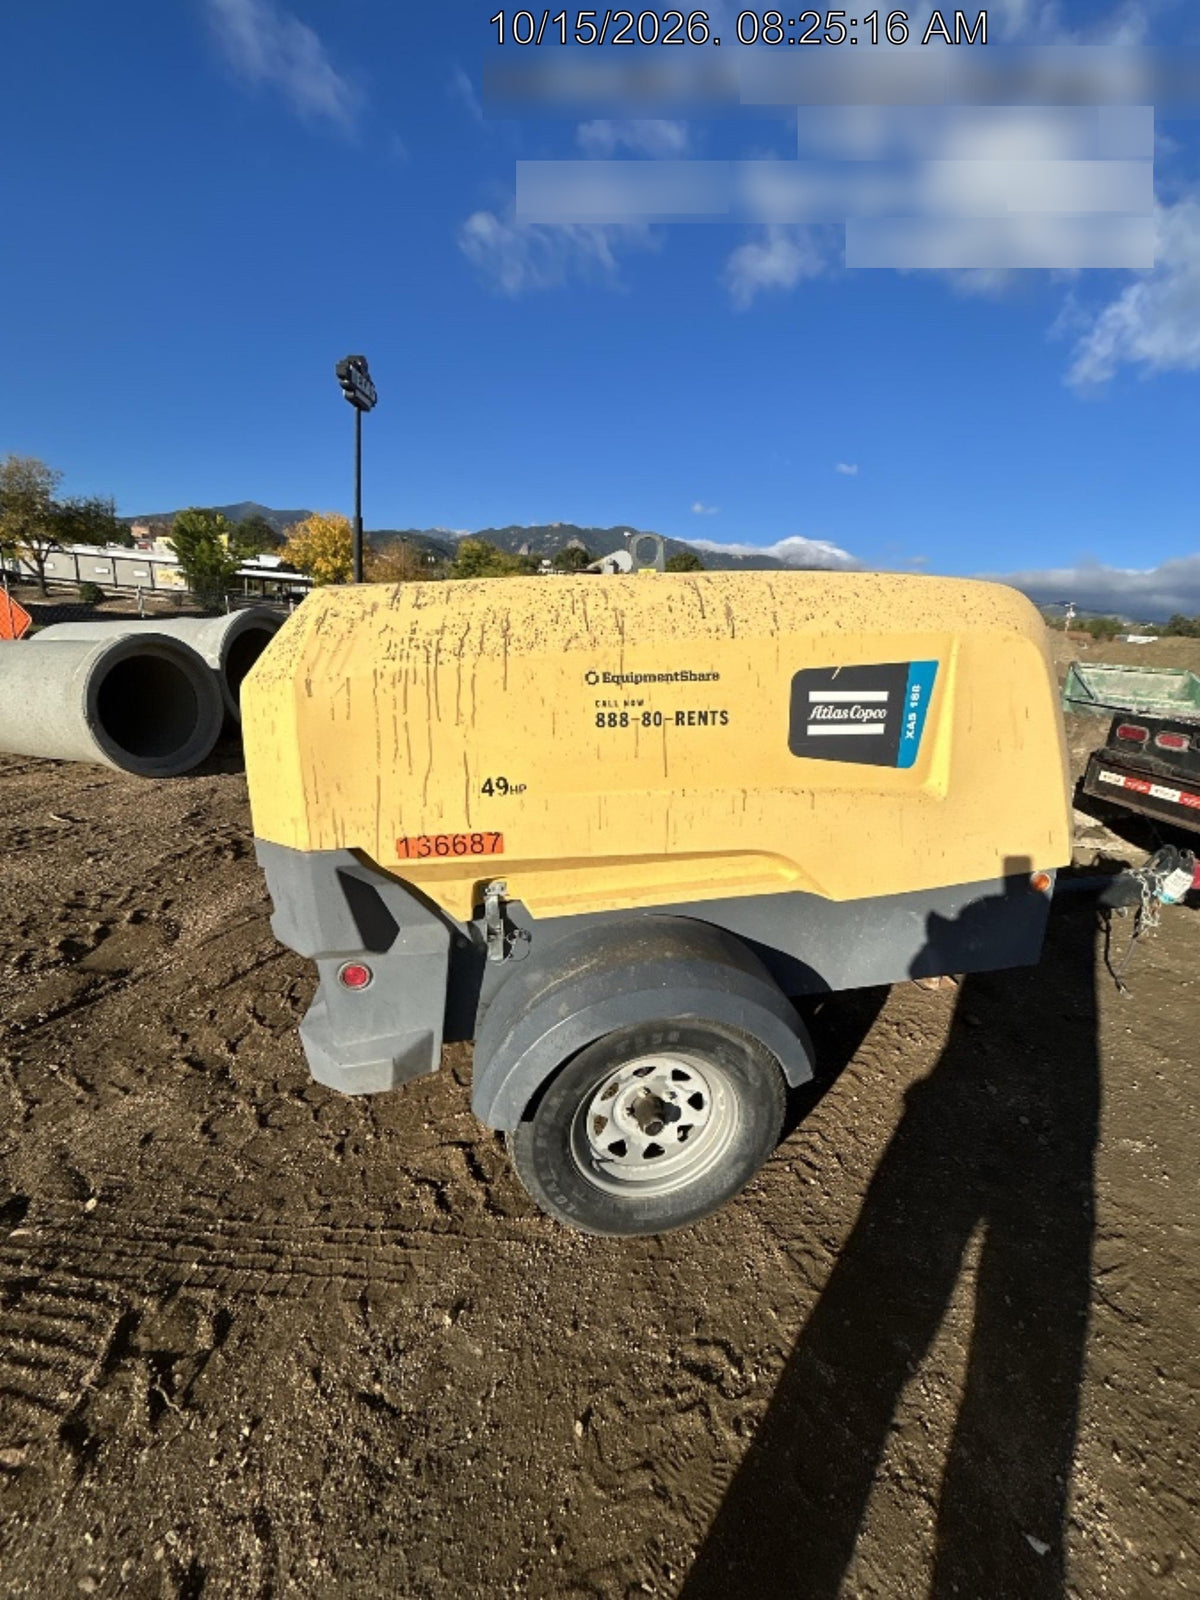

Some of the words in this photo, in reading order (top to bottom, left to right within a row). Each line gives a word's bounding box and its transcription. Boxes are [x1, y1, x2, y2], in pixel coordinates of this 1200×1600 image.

[602, 670, 720, 685] EquipmentShare
[595, 699, 619, 708] CALL
[624, 699, 645, 707] NOW
[808, 704, 849, 721] Atlas
[849, 703, 888, 722] Copco
[595, 710, 730, 728] 888-80-RENTS
[904, 712, 917, 740] XAS
[399, 831, 502, 858] 136687
